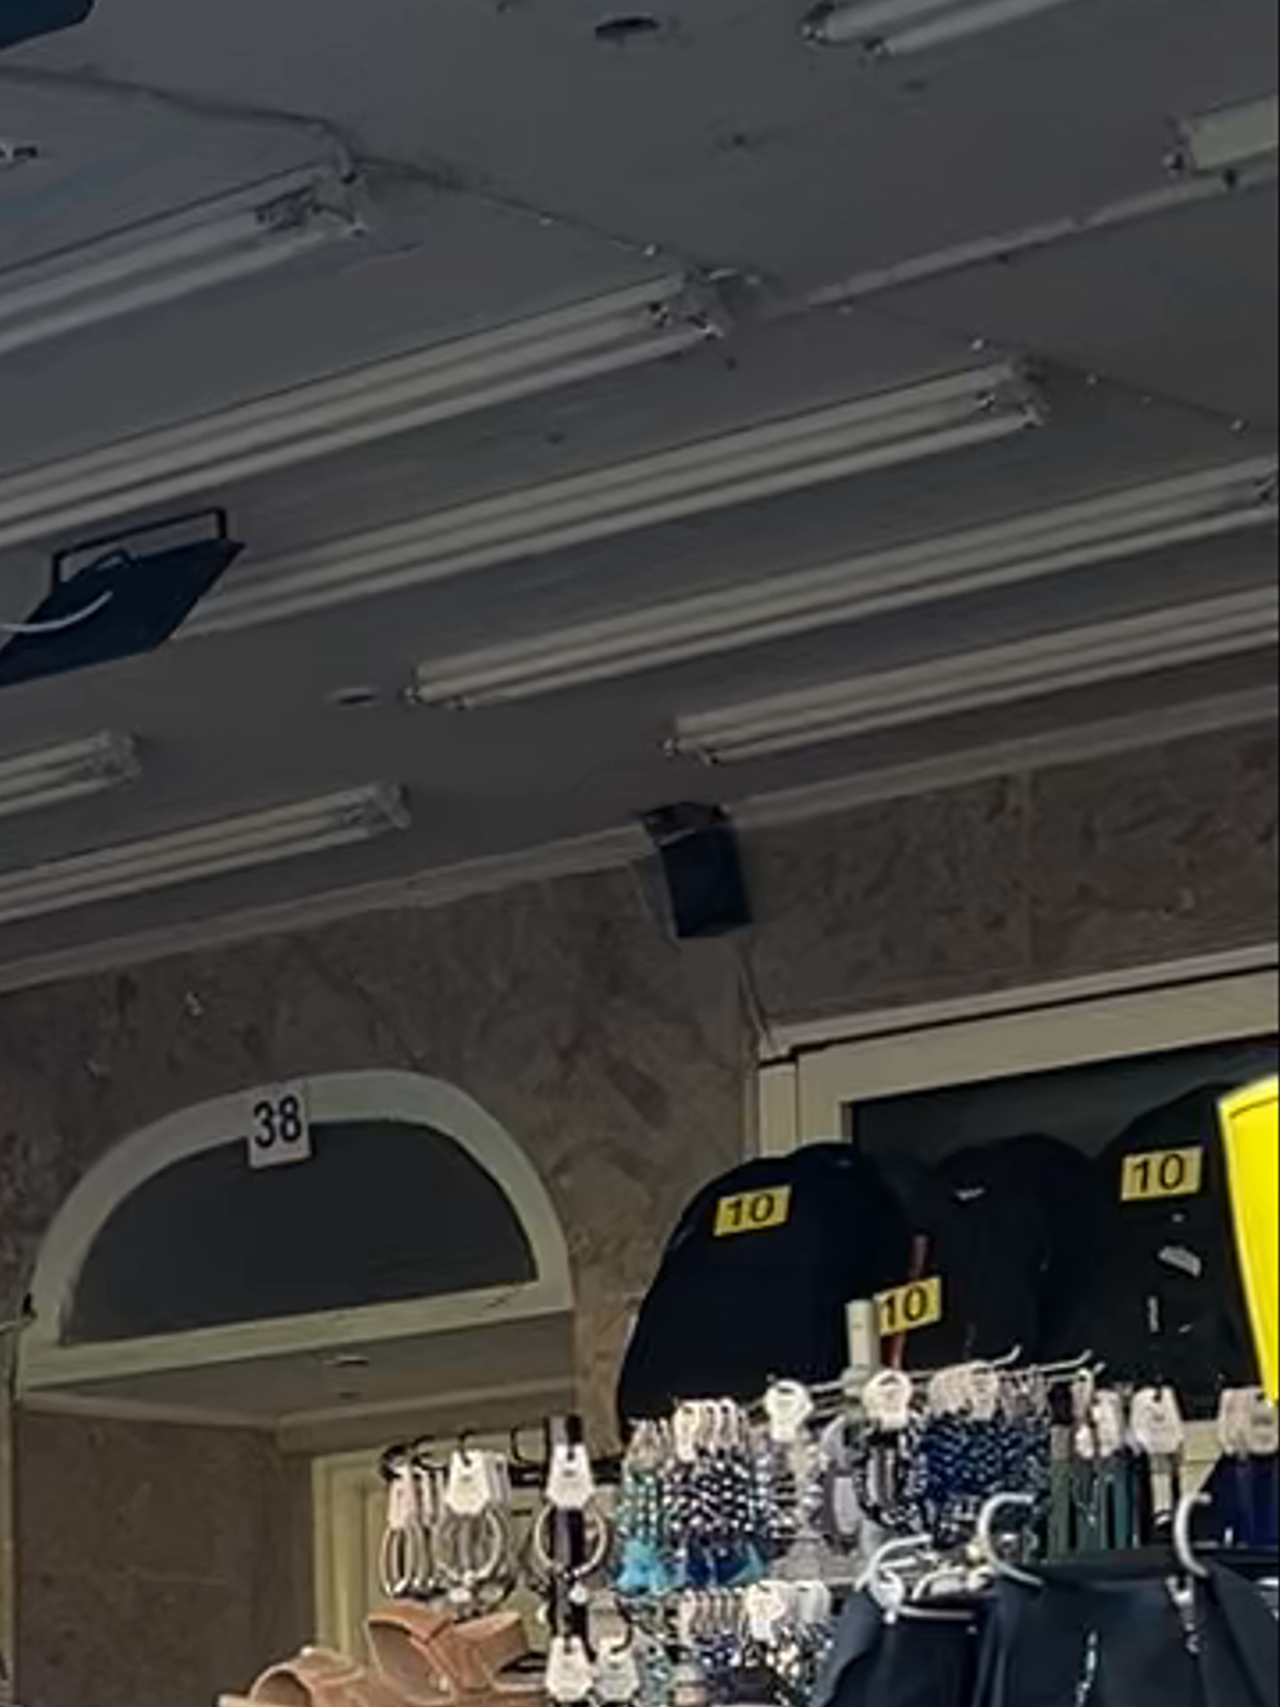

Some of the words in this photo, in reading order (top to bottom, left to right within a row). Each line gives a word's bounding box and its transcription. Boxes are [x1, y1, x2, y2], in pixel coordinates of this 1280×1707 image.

[253, 1095, 302, 1149] 38
[1133, 1153, 1185, 1192] 10
[728, 1193, 776, 1226] 10
[882, 1286, 928, 1326] 10
